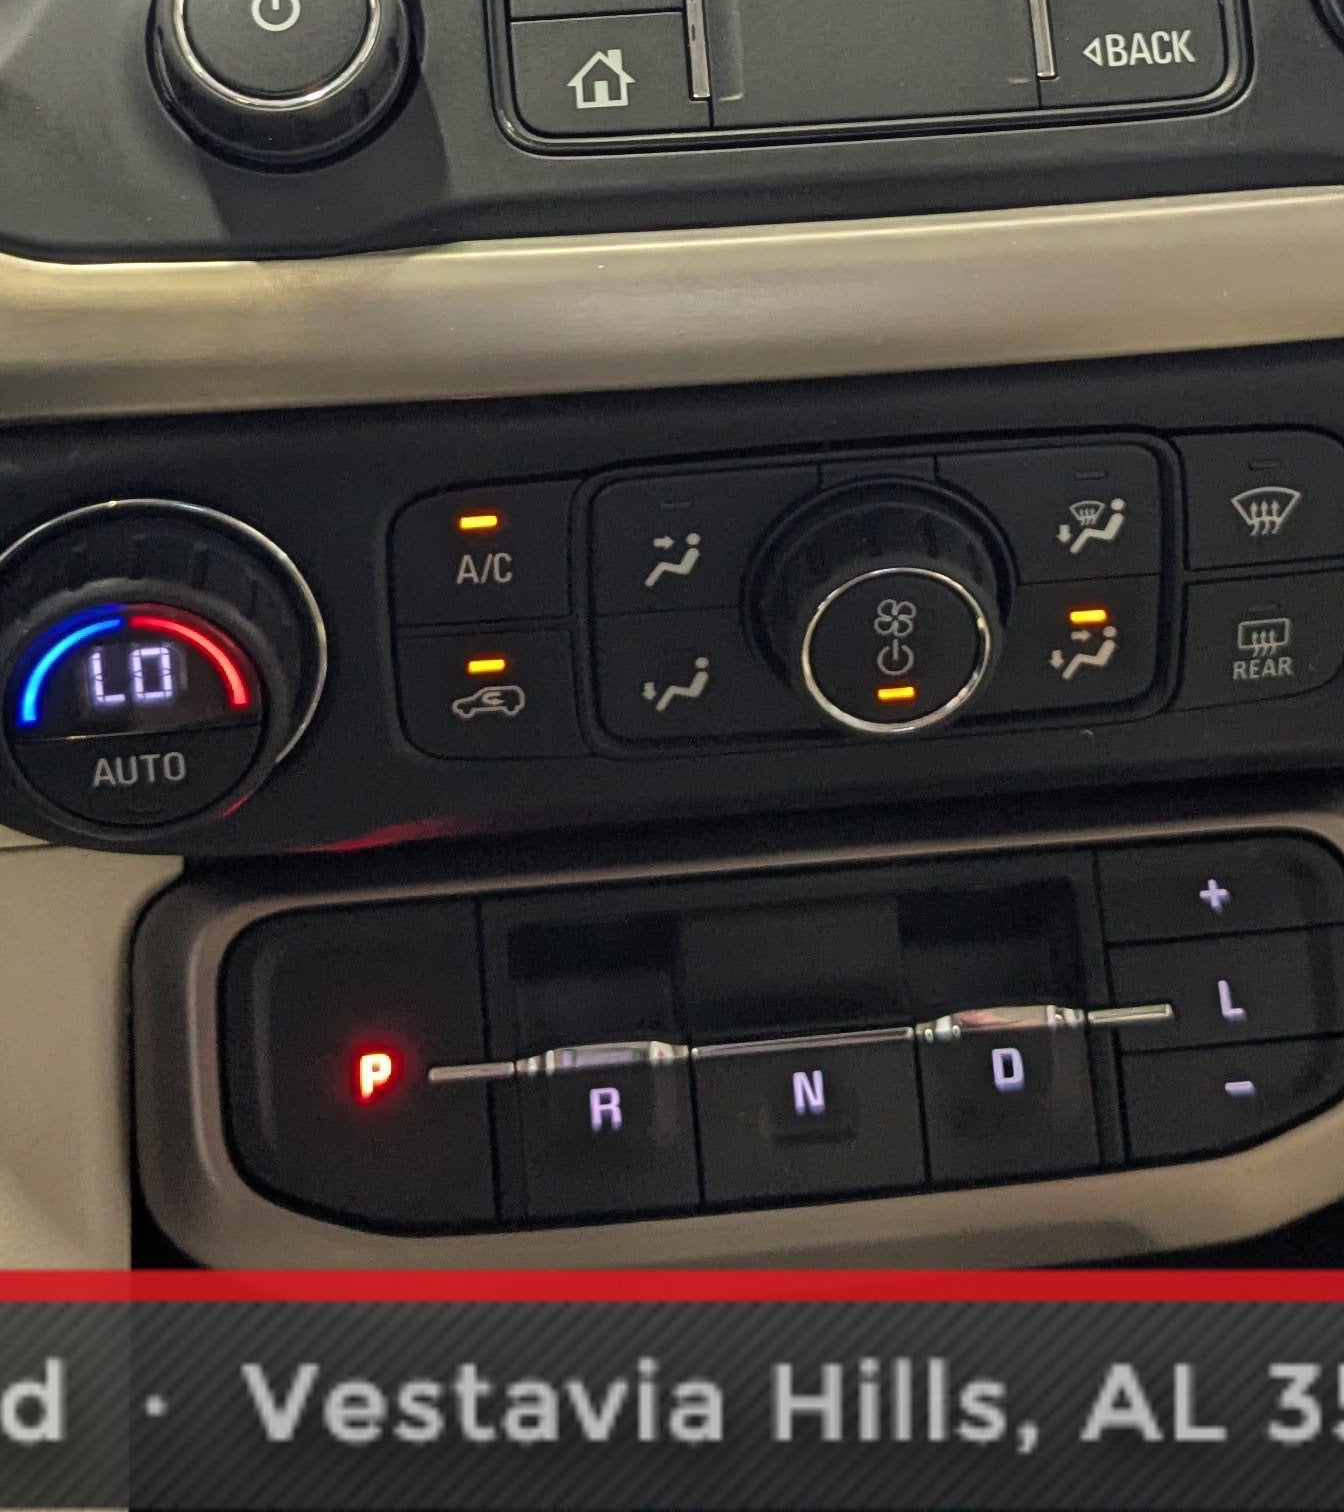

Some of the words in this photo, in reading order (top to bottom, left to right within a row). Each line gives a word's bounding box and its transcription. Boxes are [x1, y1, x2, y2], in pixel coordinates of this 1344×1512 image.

[1105, 29, 1196, 67] BACK
[455, 552, 513, 586] A/C
[89, 645, 175, 705] LO
[1232, 657, 1293, 681] REAR
[92, 752, 187, 788] AUTO
[359, 1053, 393, 1100] P
[589, 1087, 623, 1131] R
[792, 1070, 825, 1114] N
[992, 1047, 1024, 1090] D
[1217, 980, 1246, 1021] L
